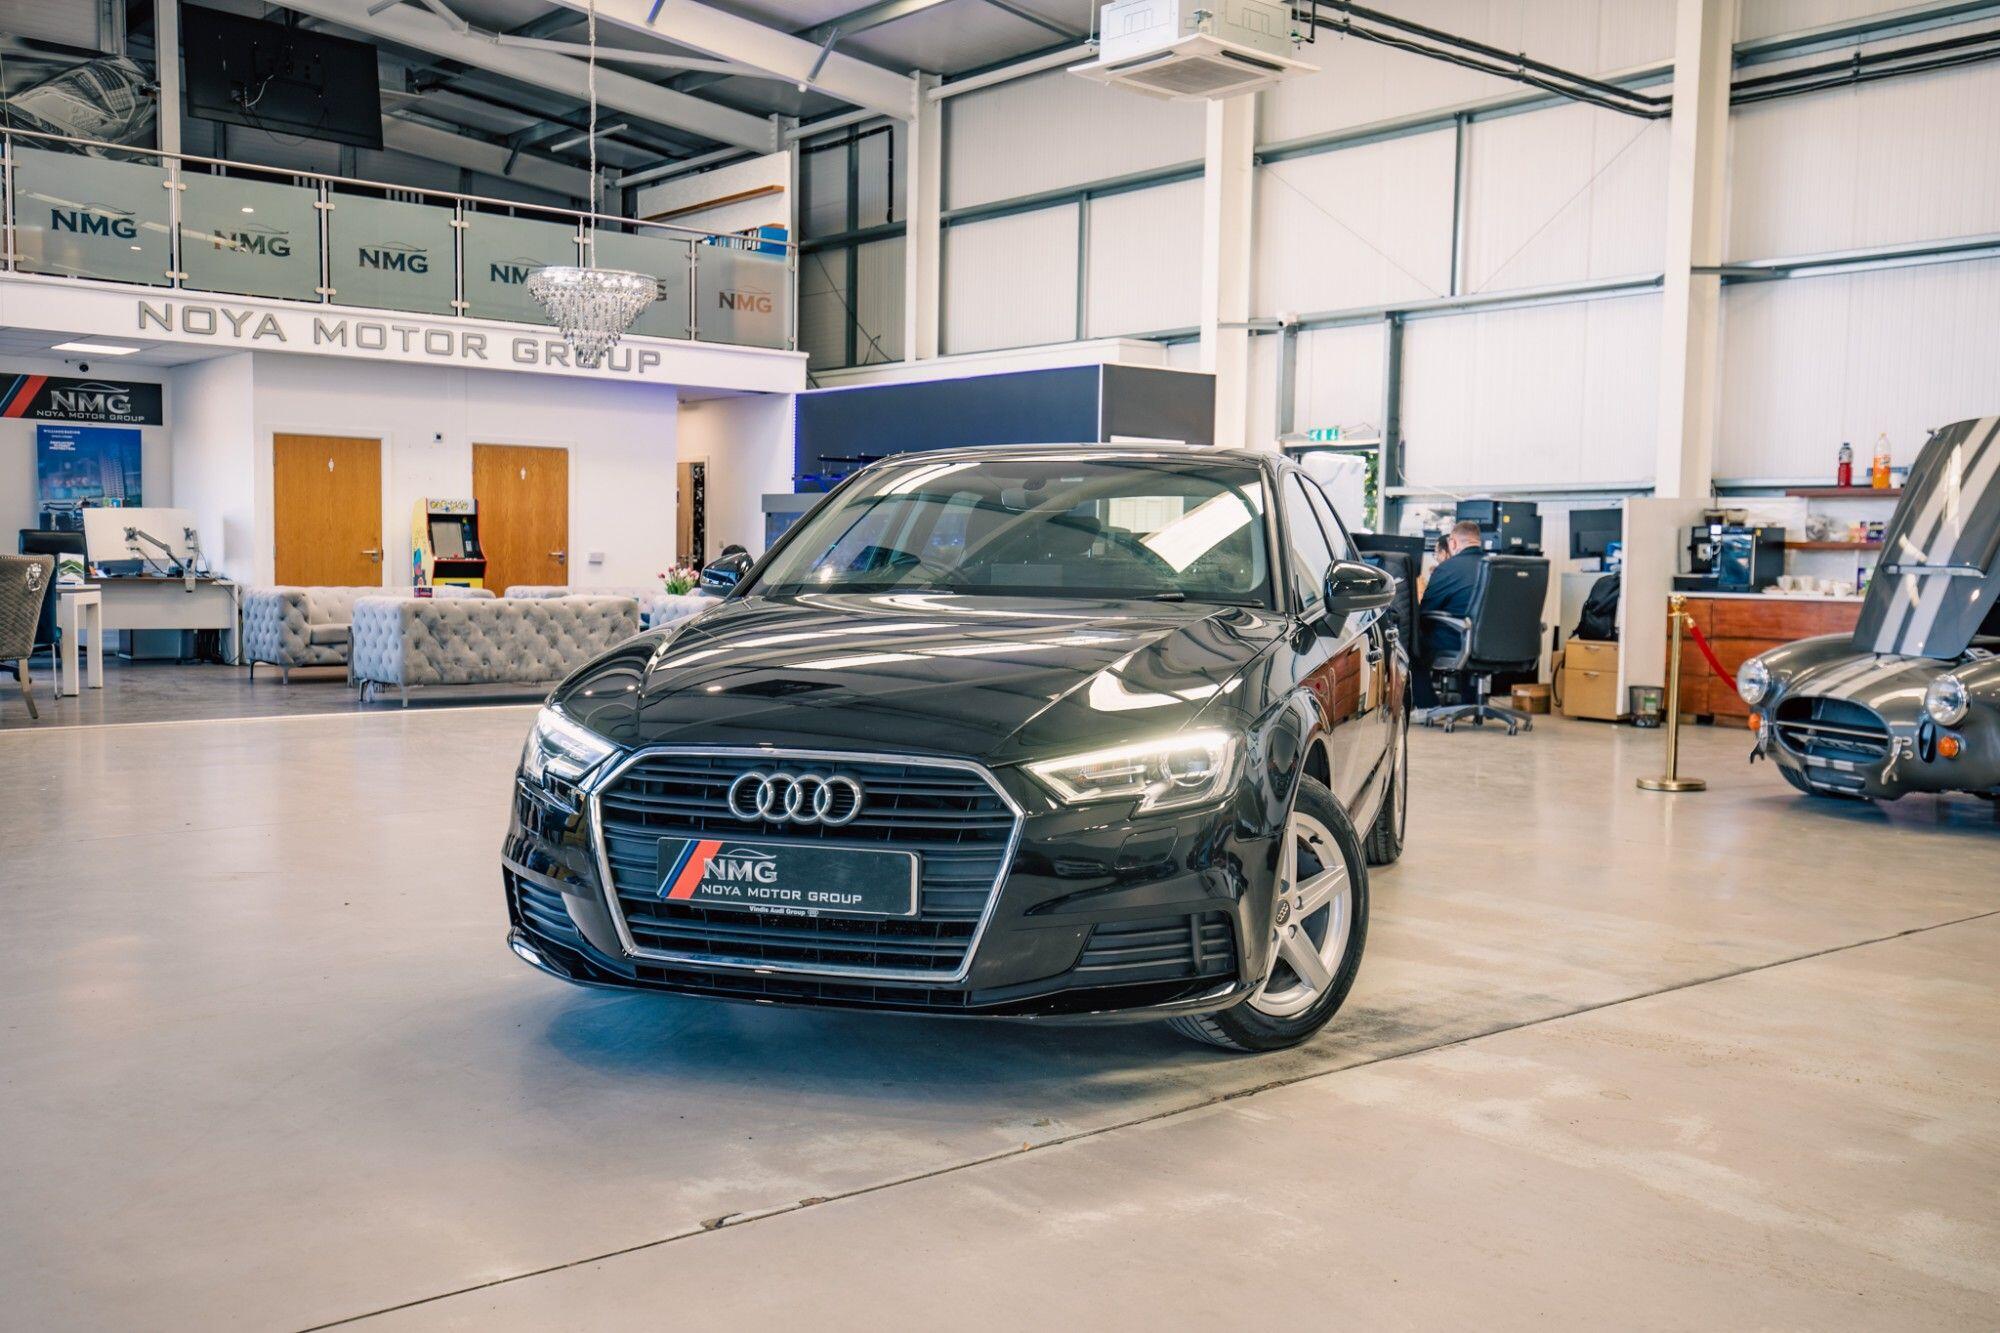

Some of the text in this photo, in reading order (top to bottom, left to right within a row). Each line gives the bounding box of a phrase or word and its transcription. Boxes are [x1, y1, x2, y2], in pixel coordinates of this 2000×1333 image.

[51, 208, 137, 239] NMG
[214, 229, 290, 257] NMG
[358, 247, 428, 274] NMG
[489, 263, 530, 285] NM
[719, 291, 772, 313] NMG
[138, 300, 287, 342] NOYA
[314, 316, 488, 361] MOTOR
[50, 390, 131, 414] NMG
[36, 410, 145, 422] NOYA MOTOR GROUP
[703, 857, 777, 883] NMG
[701, 884, 862, 904] NOYA MOTOR GROUP
[786, 908, 806, 917] Group
